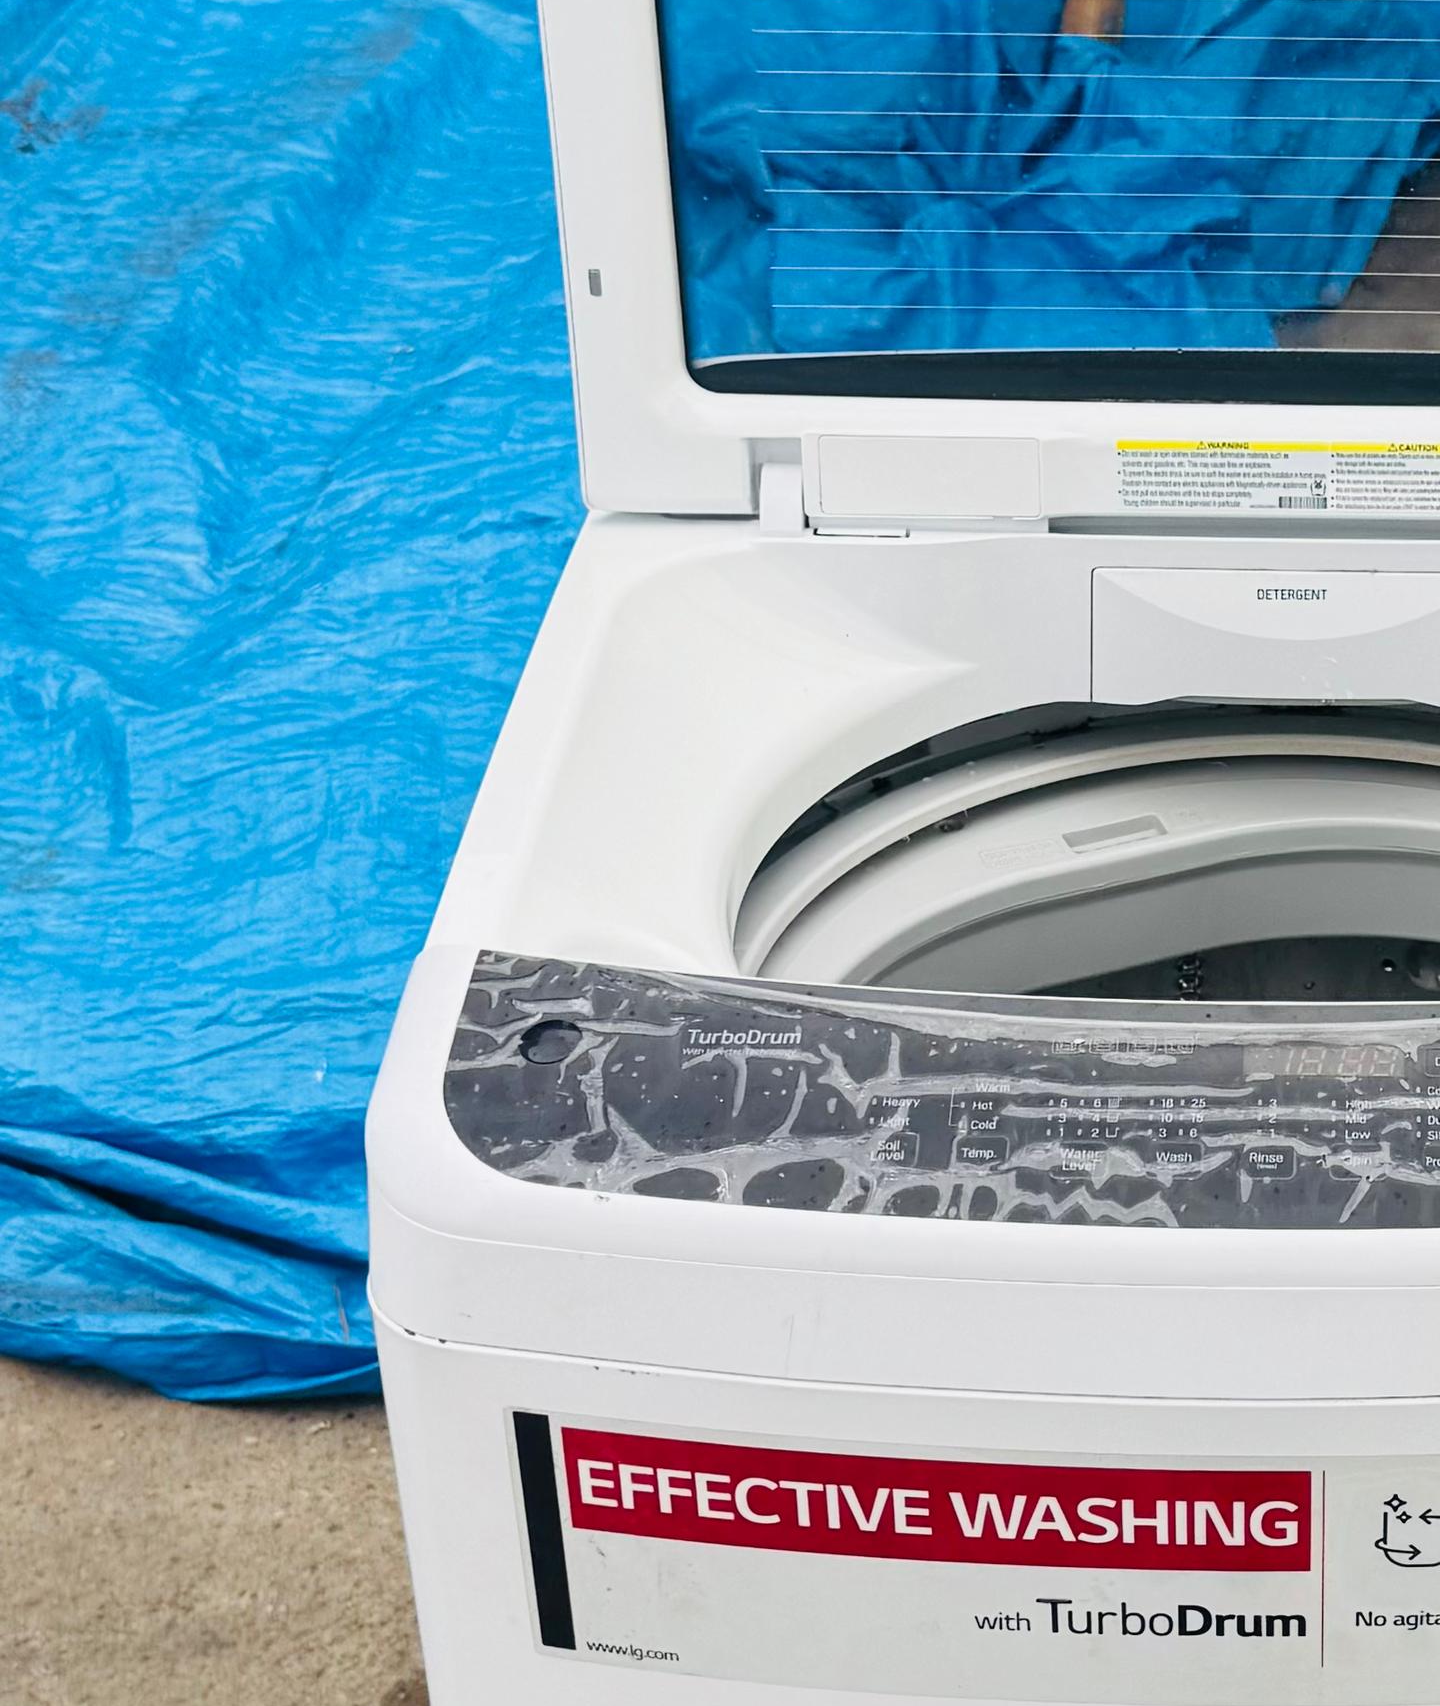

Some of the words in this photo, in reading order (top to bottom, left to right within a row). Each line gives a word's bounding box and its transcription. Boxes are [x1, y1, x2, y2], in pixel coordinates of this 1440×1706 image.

[1257, 589, 1327, 600] DETERGENT
[688, 1029, 802, 1045] TurboDrum
[975, 1083, 1011, 1093] Warm
[882, 1097, 920, 1108] Heavy
[972, 1101, 993, 1111] Hot
[1060, 1098, 1068, 1108] 5
[1093, 1099, 1101, 1108] 6
[1191, 1099, 1206, 1108] 25
[1269, 1099, 1277, 1108] 3
[1345, 1100, 1372, 1111] High
[1161, 1113, 1173, 1123] 10
[1268, 1115, 1277, 1124] 2
[1345, 1115, 1367, 1125] Mid
[971, 1119, 997, 1130] Cold
[1091, 1128, 1100, 1138] 2
[1159, 1128, 1167, 1138] 3
[1345, 1129, 1371, 1140] Low
[878, 1140, 901, 1152] Soil
[870, 1150, 905, 1161] Level
[961, 1148, 997, 1161] Temp.
[1156, 1152, 1193, 1163] Wash
[1250, 1151, 1284, 1163] Rinse
[577, 1459, 933, 1535] EFFECTIVE
[949, 1492, 1299, 1547] WASHING
[974, 1611, 1031, 1632] with
[1036, 1597, 1306, 1637] TurboDrum
[1355, 1611, 1387, 1627] No
[586, 1641, 680, 1662] www.lg.com
